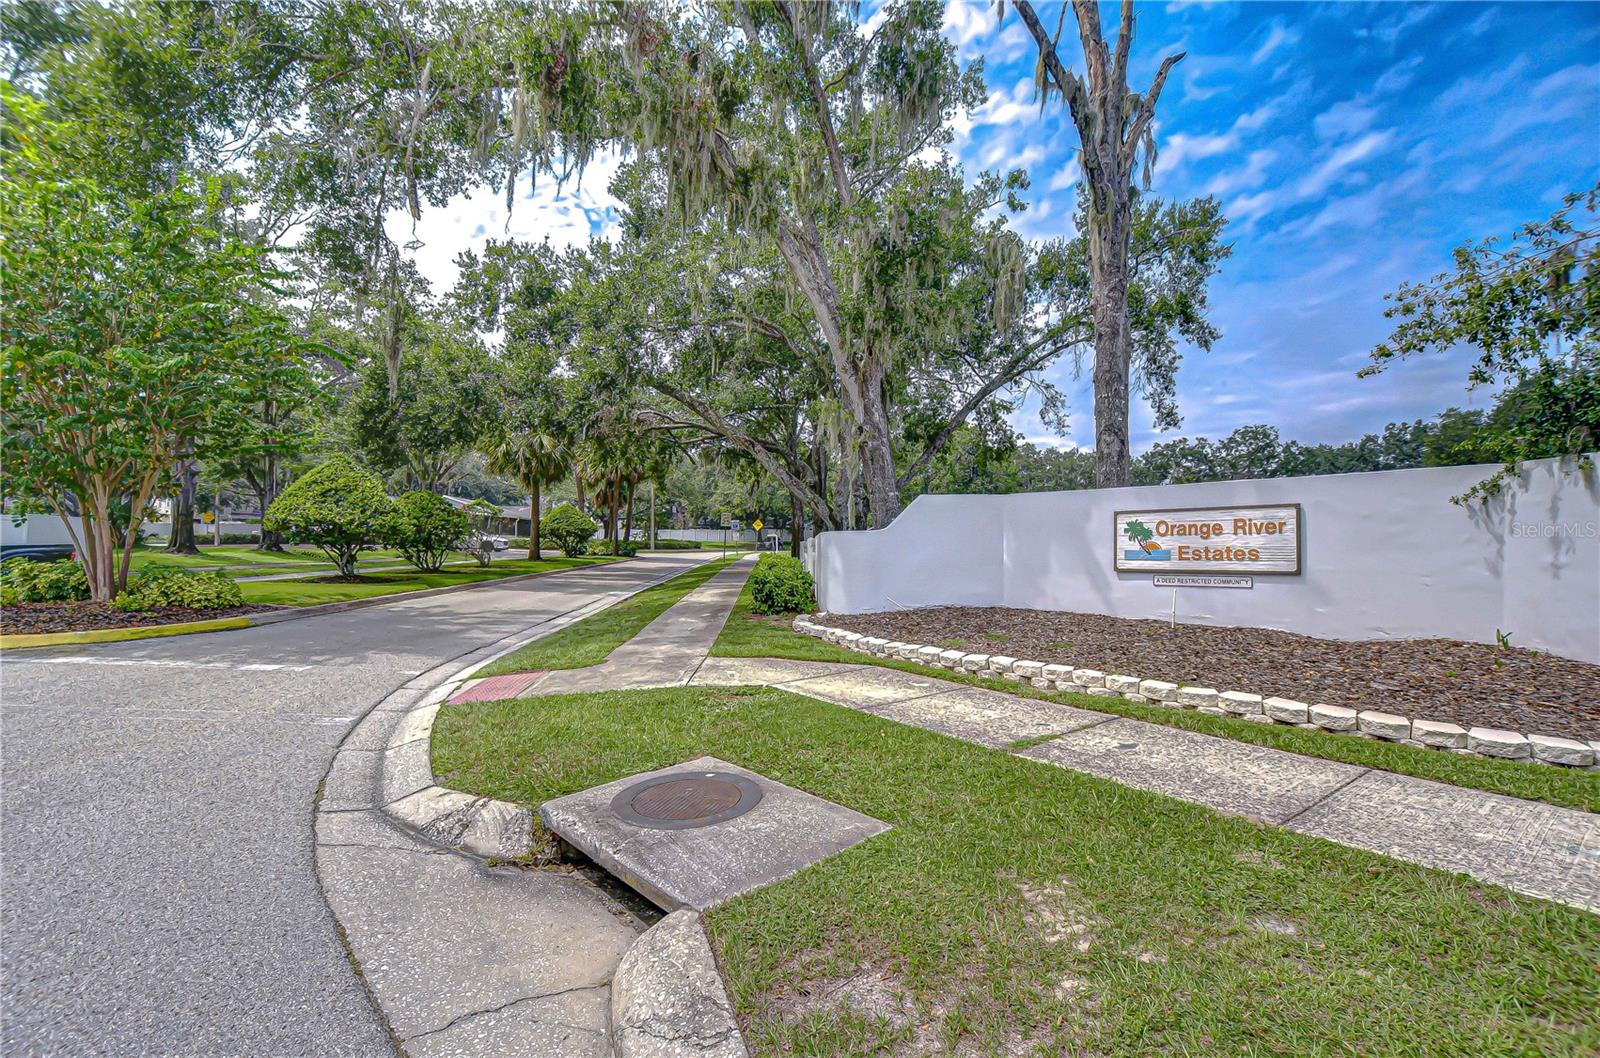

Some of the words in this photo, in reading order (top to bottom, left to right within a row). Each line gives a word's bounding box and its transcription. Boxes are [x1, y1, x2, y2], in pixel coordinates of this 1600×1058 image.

[1155, 519, 1224, 540] Orange
[1233, 518, 1287, 536] River
[1177, 545, 1261, 561] Estates
